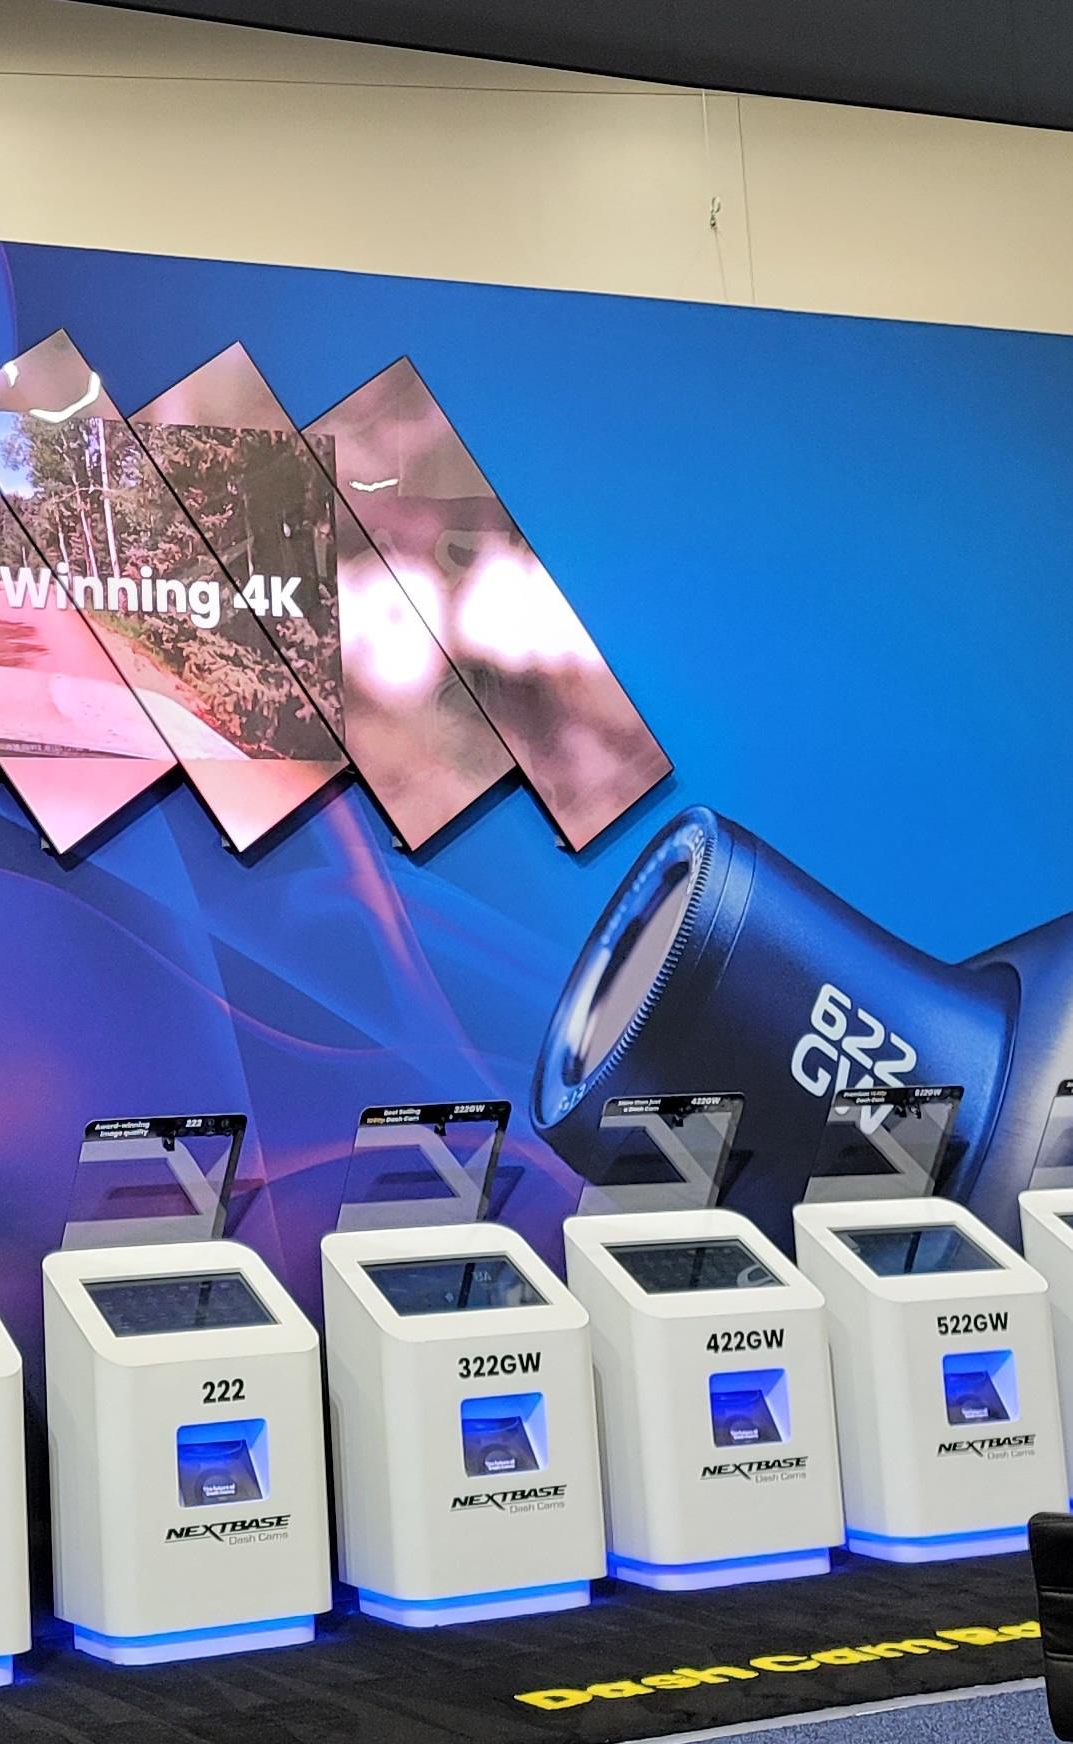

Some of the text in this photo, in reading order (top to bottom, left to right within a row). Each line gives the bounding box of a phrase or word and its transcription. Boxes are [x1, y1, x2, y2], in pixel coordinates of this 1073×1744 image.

[233, 575, 303, 619] 4K
[811, 983, 917, 1087] 622
[791, 1033, 894, 1135] GW
[937, 1312, 1008, 1335] 522GW
[707, 1329, 784, 1353] 422GW
[458, 1352, 541, 1379] 322GW
[202, 1379, 245, 1404] 222
[937, 1434, 1036, 1457] NEXTBASE
[700, 1456, 808, 1480] NEXTBASE
[755, 1473, 778, 1484] Dash
[450, 1484, 567, 1512] NEXTBASE
[509, 1500, 565, 1514] Dash Cams
[164, 1514, 291, 1543] NEXTBASE
[229, 1531, 288, 1545] Dash Cams
[514, 1667, 758, 1710] Dash
[749, 1638, 959, 1673] Cam
